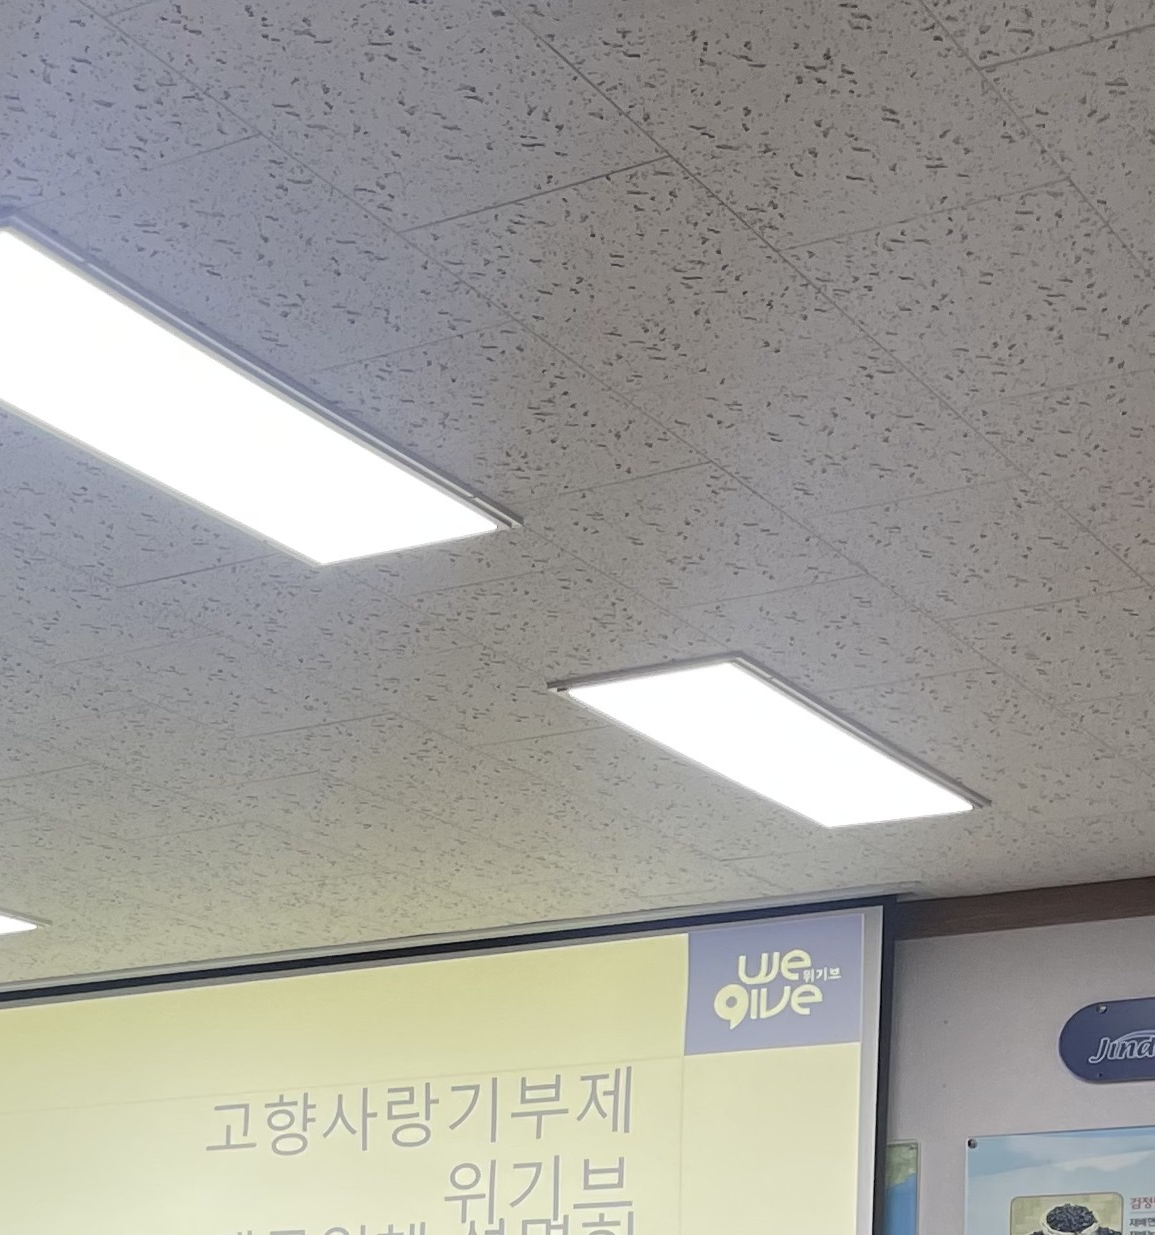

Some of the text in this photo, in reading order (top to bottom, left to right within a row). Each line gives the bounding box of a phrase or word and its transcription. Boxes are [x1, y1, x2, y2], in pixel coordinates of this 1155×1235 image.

[802, 966, 842, 983] 위기브
[205, 1066, 633, 1156] 고향사랑기부제
[444, 1155, 633, 1225] 위기브
[1129, 1197, 1155, 1210] 검정
